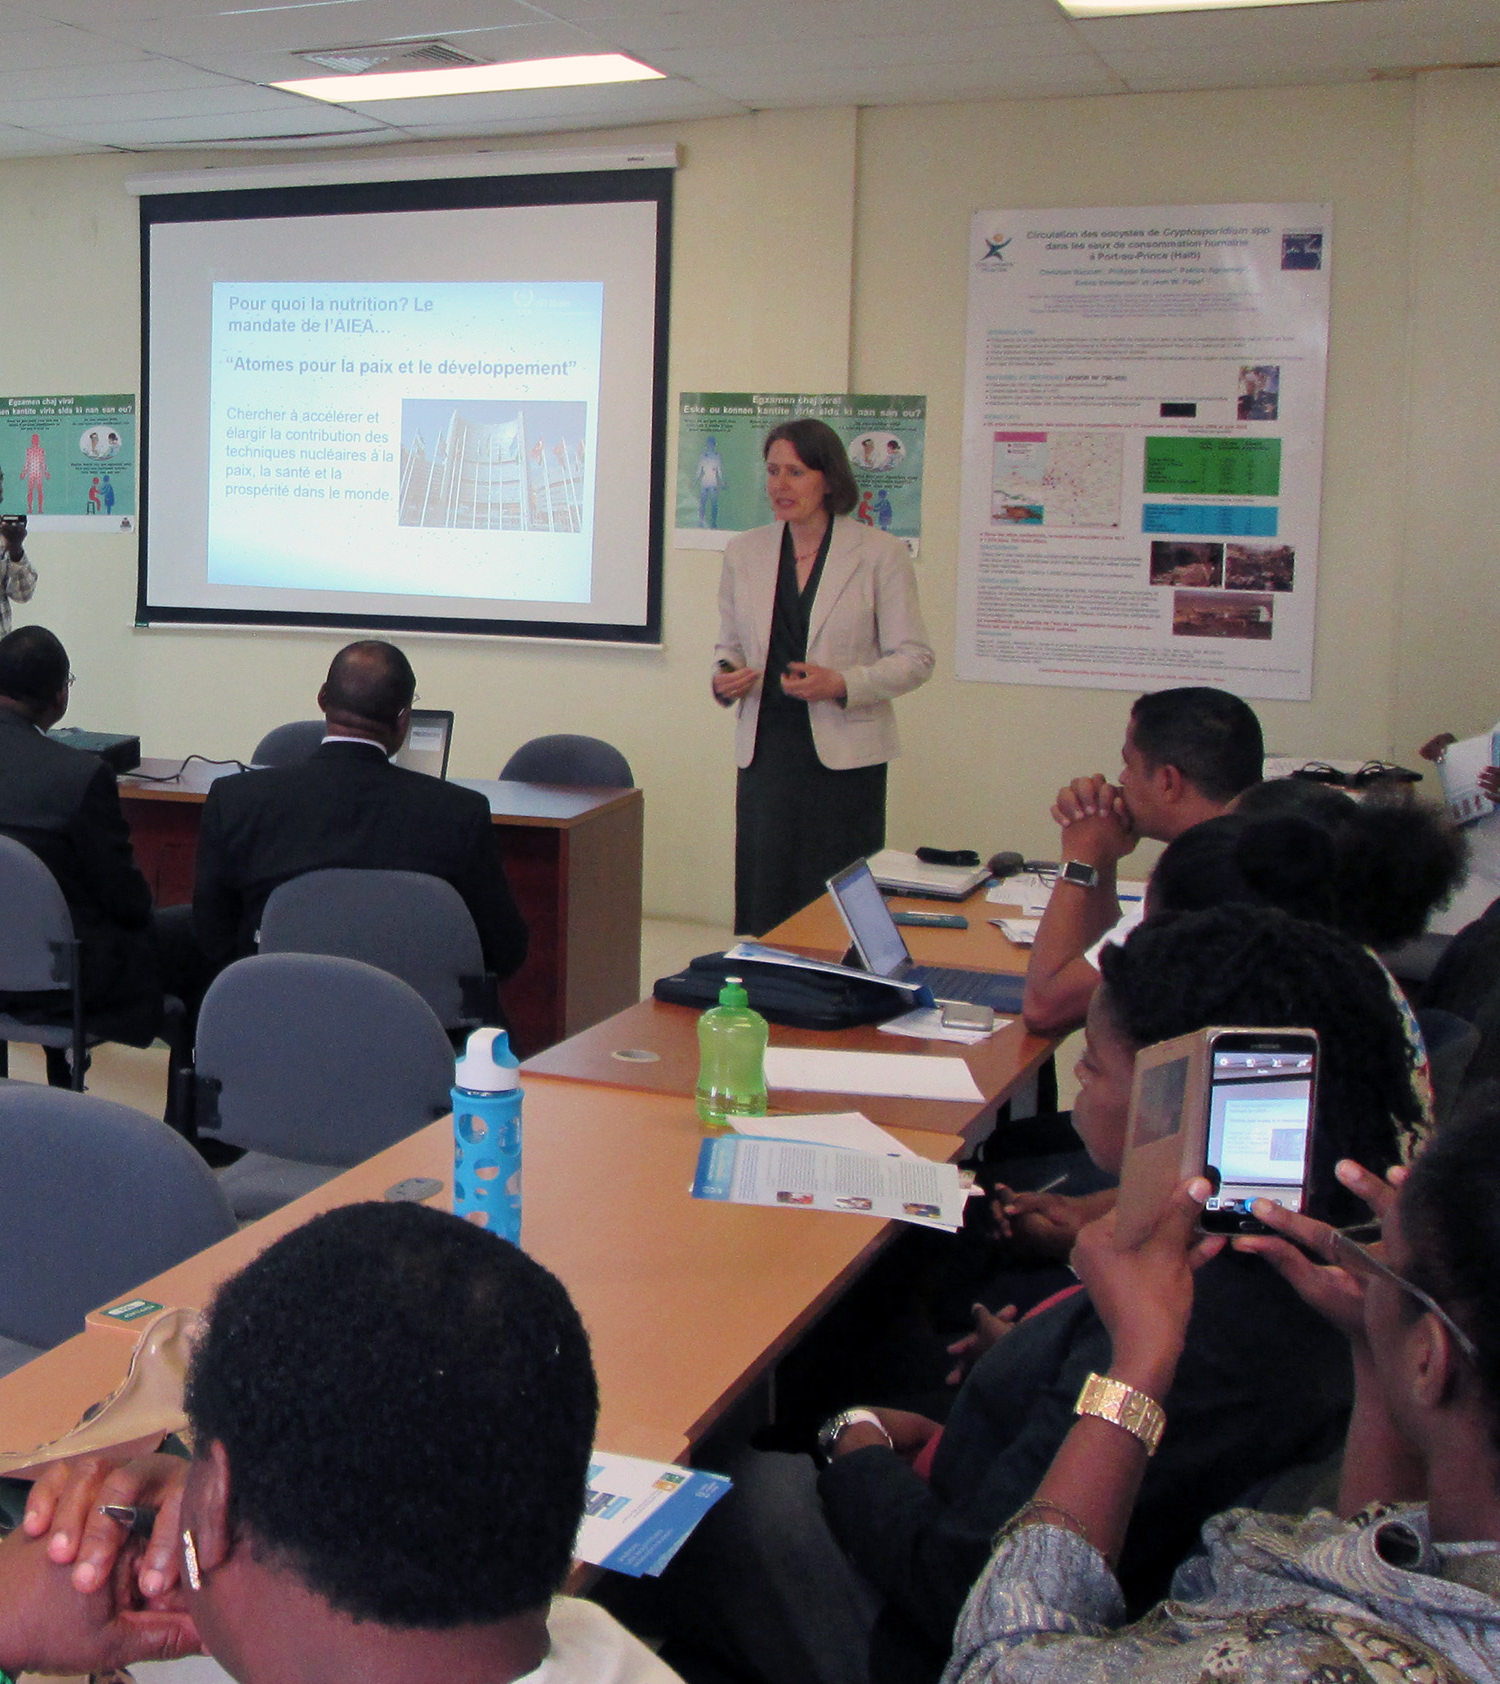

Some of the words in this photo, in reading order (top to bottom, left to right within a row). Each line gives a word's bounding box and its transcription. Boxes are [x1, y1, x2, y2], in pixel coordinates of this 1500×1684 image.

[1027, 231, 1078, 239] Circulation
[1081, 230, 1098, 238] des
[1148, 229, 1160, 237] de
[1163, 227, 1248, 238] Cryptosporidium
[1046, 241, 1068, 250] dans
[1113, 241, 1125, 249] de
[1128, 239, 1201, 248] consommation
[229, 297, 266, 311] Pour
[271, 297, 306, 314] quoi
[311, 297, 324, 311] la
[330, 297, 409, 311] nutrition?
[414, 297, 433, 312] Le
[228, 318, 296, 332] mandate
[301, 318, 320, 332] de
[299, 360, 336, 375] pour
[341, 359, 354, 372] la
[360, 359, 393, 376] paix
[398, 360, 414, 374] et
[418, 360, 432, 374] le
[8, 399, 41, 407] Egzamen
[42, 398, 57, 407] chaj
[58, 397, 74, 405] viral
[752, 396, 796, 405] Egzamen
[12, 407, 36, 415] kantite
[39, 407, 54, 415] viris
[76, 406, 83, 414] ki
[227, 407, 286, 421] Chercher
[290, 409, 298, 422] à
[302, 410, 363, 423] accélérer
[366, 412, 380, 424] et
[684, 406, 706, 414] Eske
[723, 406, 753, 415] konnen
[757, 406, 790, 415] kantite
[844, 407, 853, 416] ki
[858, 409, 876, 417] nan
[880, 409, 898, 417] san
[903, 409, 922, 418] ou?
[226, 426, 267, 442] élargir
[270, 427, 281, 440] la
[286, 429, 361, 443] contribution
[365, 431, 389, 444] des
[226, 445, 296, 461] techniques
[300, 448, 367, 461] nucléaires
[371, 449, 379, 462] à
[382, 449, 394, 462] la
[226, 464, 256, 478] paix,
[260, 464, 271, 477] la
[275, 466, 310, 478] santé
[315, 467, 327, 479] et
[331, 467, 342, 480] la
[225, 485, 289, 498] prospérité
[293, 486, 325, 498] dans
[329, 486, 340, 499] le
[345, 488, 393, 500] monde.
